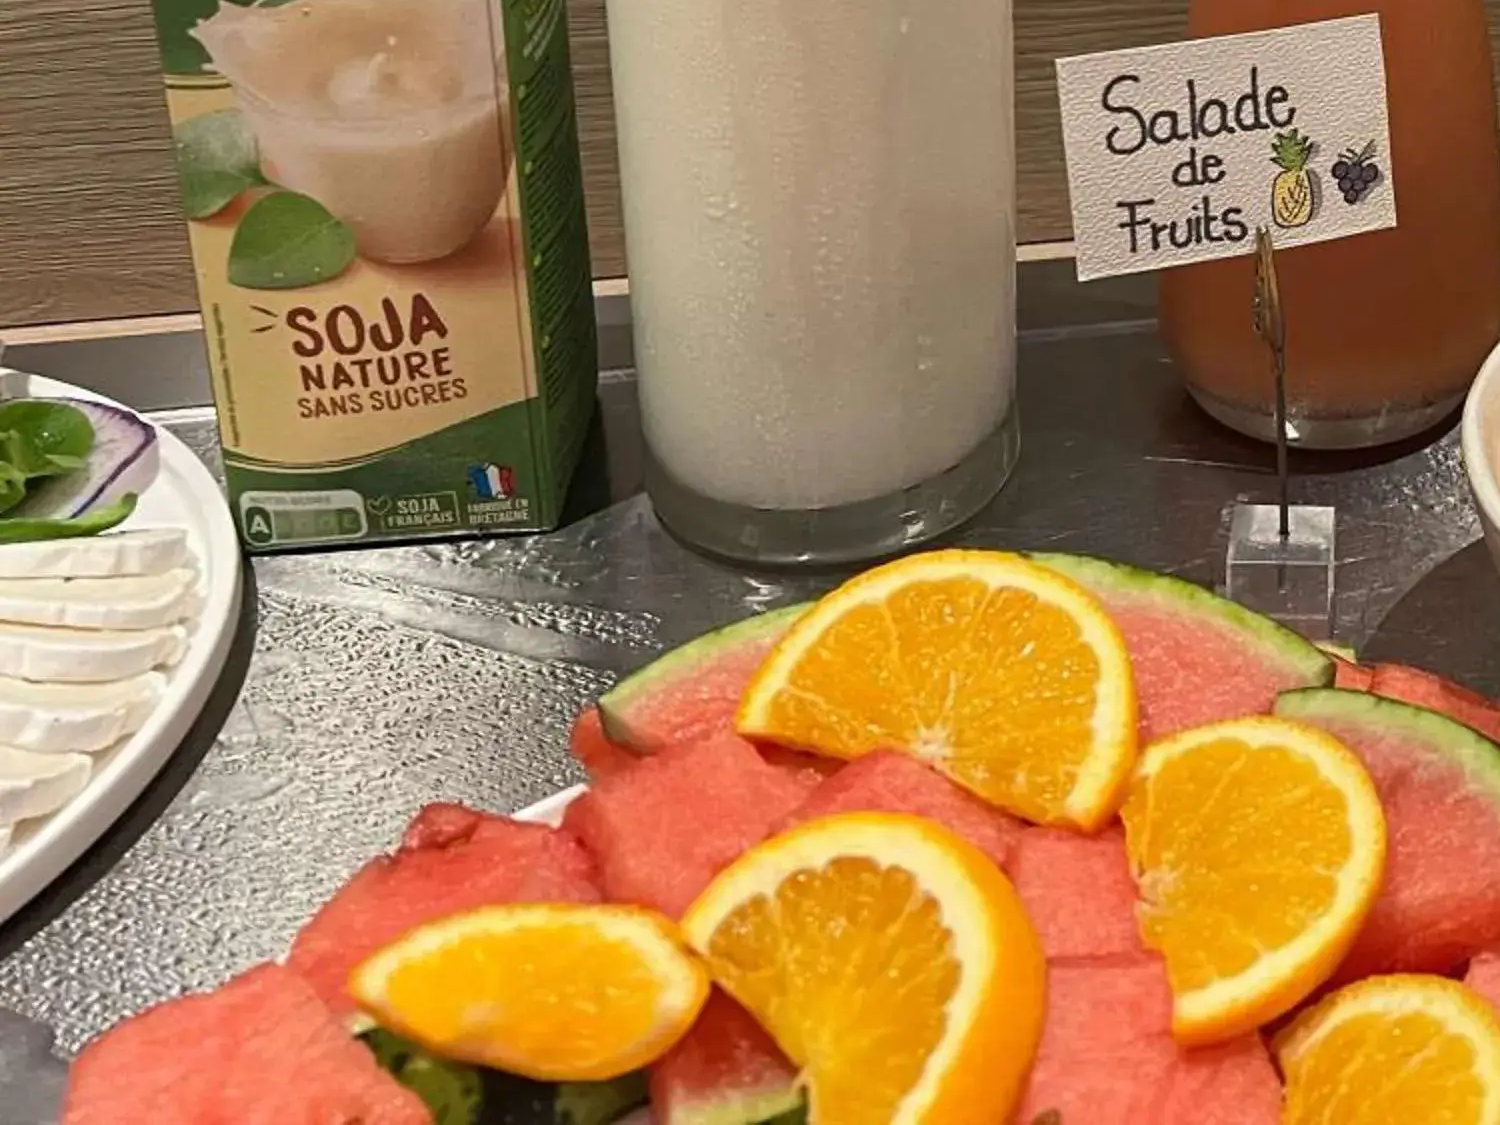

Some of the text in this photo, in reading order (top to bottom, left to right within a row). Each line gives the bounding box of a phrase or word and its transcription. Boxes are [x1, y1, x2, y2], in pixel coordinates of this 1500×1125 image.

[1100, 65, 1297, 155] Salade
[1171, 146, 1227, 188] de
[1116, 195, 1249, 253] Fruits
[285, 292, 449, 358] SOJA
[300, 347, 453, 392] NATURE
[297, 377, 469, 419] SANS SUCRES
[250, 514, 271, 535] A
[397, 497, 440, 515] SOJA
